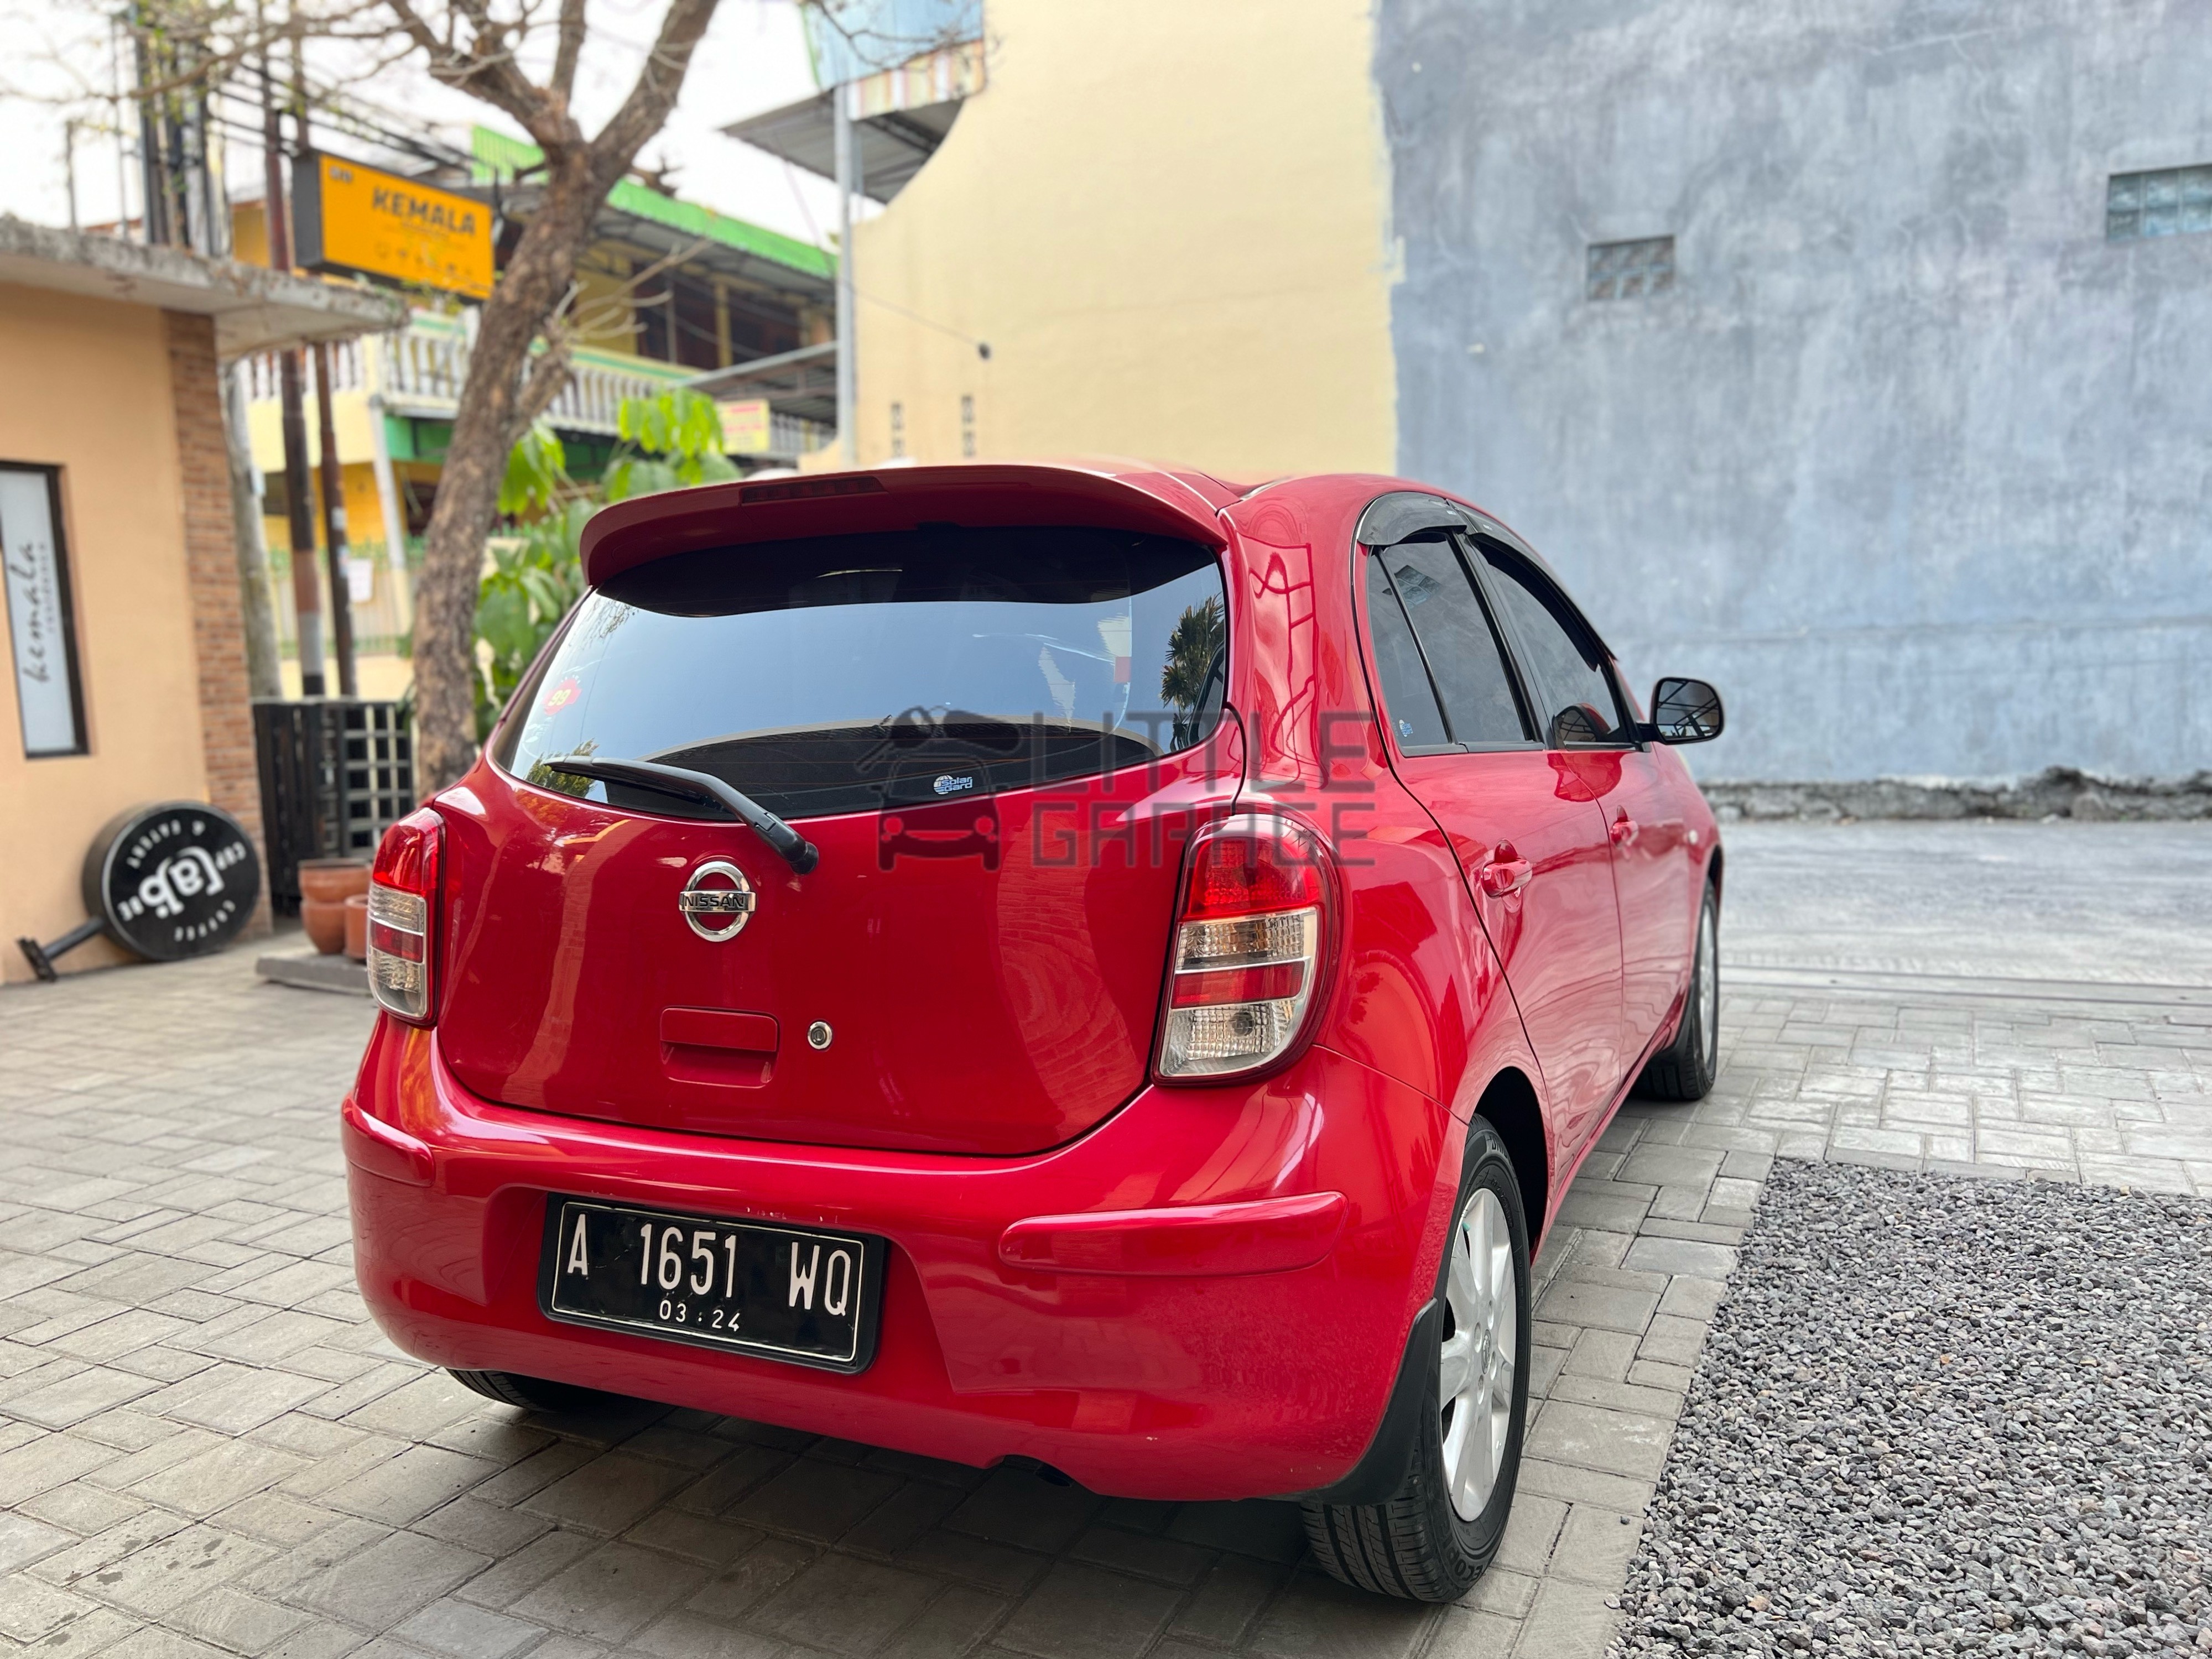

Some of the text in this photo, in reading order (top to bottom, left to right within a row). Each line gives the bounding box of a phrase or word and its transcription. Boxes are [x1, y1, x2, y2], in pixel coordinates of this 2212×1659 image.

[372, 186, 475, 236] KEMALA
[944, 779, 972, 792] Gard
[684, 896, 744, 907] NISSAN
[568, 1214, 851, 1317] A 1651 WQ
